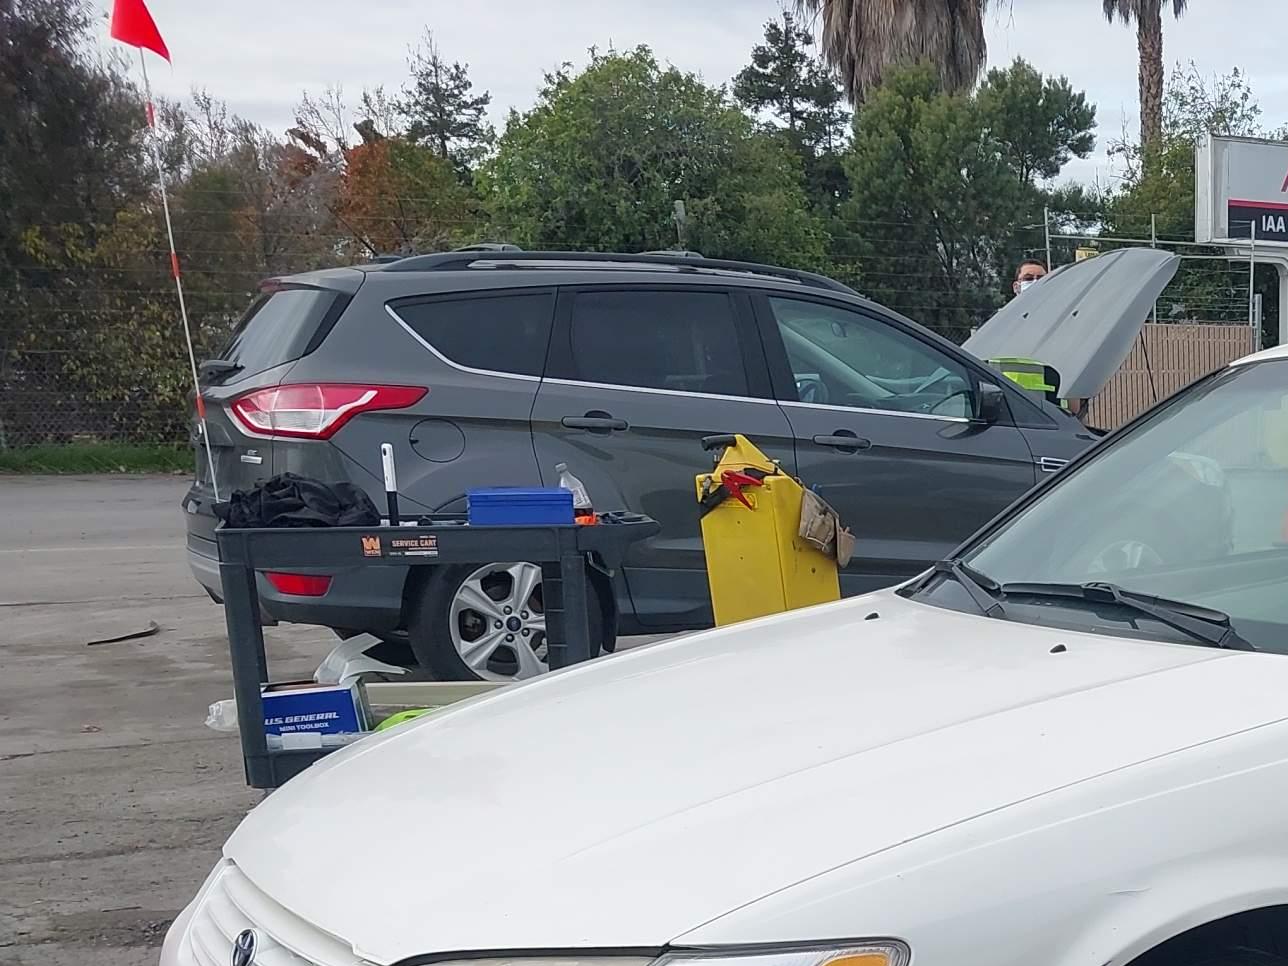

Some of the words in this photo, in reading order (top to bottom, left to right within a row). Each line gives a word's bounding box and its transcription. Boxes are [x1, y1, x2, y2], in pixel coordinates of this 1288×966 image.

[1262, 214, 1286, 233] IAA
[284, 711, 340, 724] GENERAL
[297, 722, 330, 731] TOOLBOX
